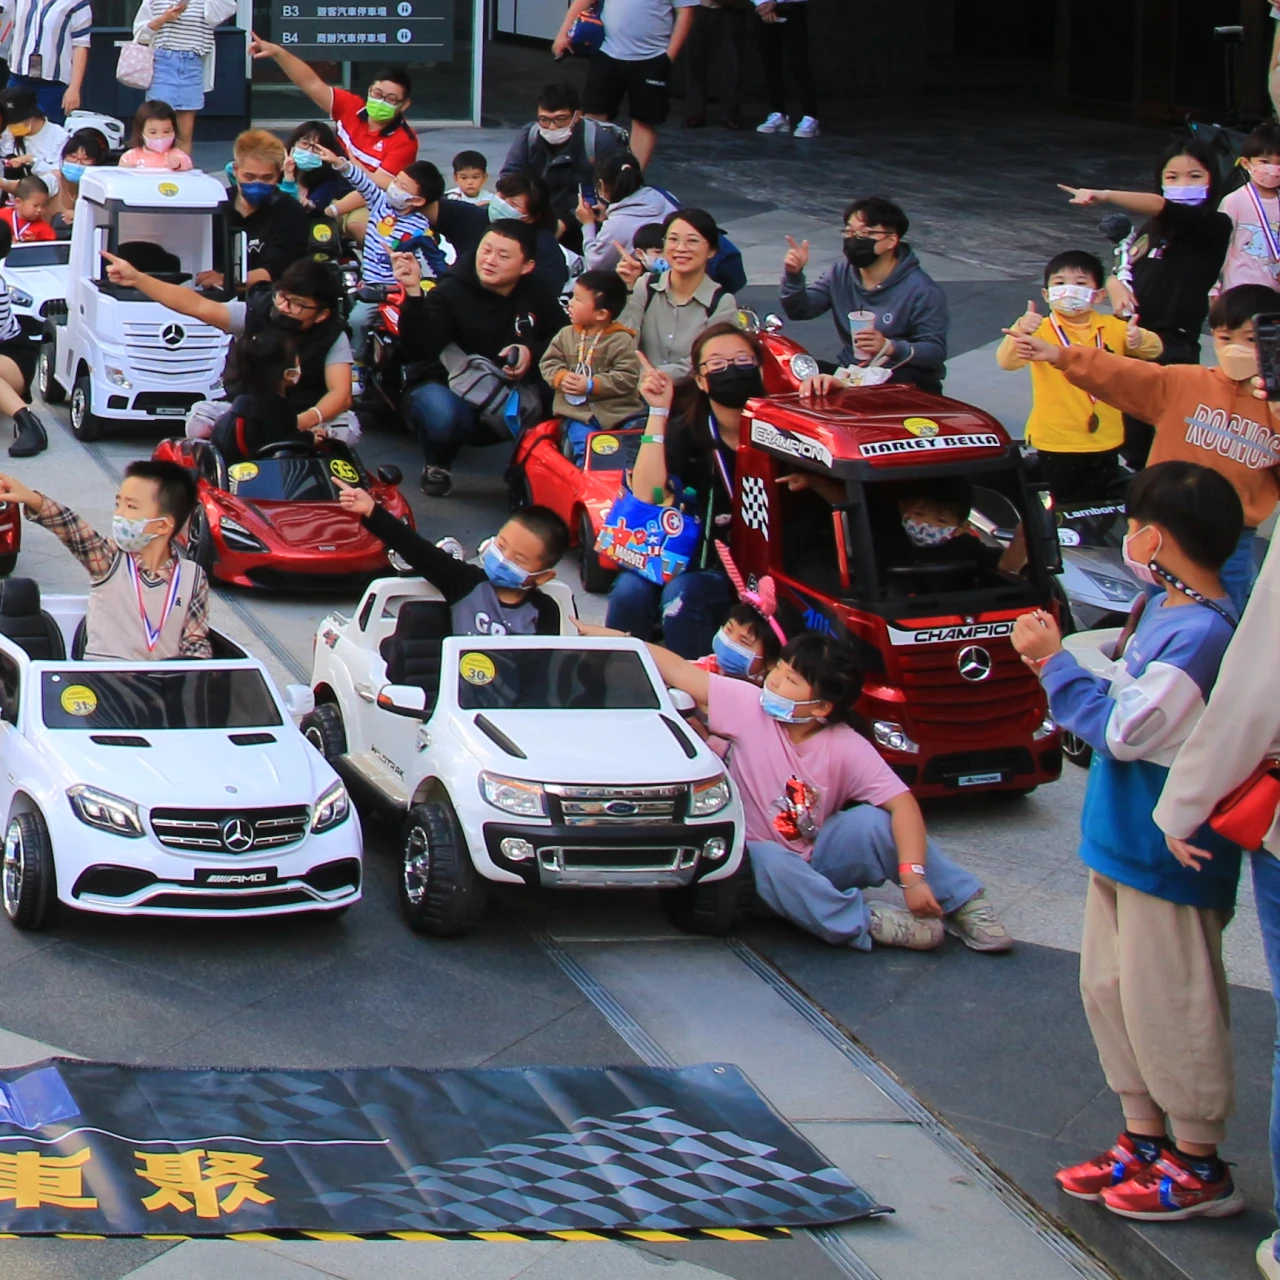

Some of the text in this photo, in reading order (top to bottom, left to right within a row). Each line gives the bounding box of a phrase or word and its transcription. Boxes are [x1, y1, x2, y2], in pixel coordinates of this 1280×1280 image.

[282, 5, 299, 17] B3
[282, 32, 299, 43] B4
[753, 428, 823, 462] CHAMPION
[861, 433, 999, 455] HARLEY BELLA
[1062, 503, 1126, 519] Lamborg
[615, 542, 647, 570] MARVEL
[229, 871, 269, 884] AMG
